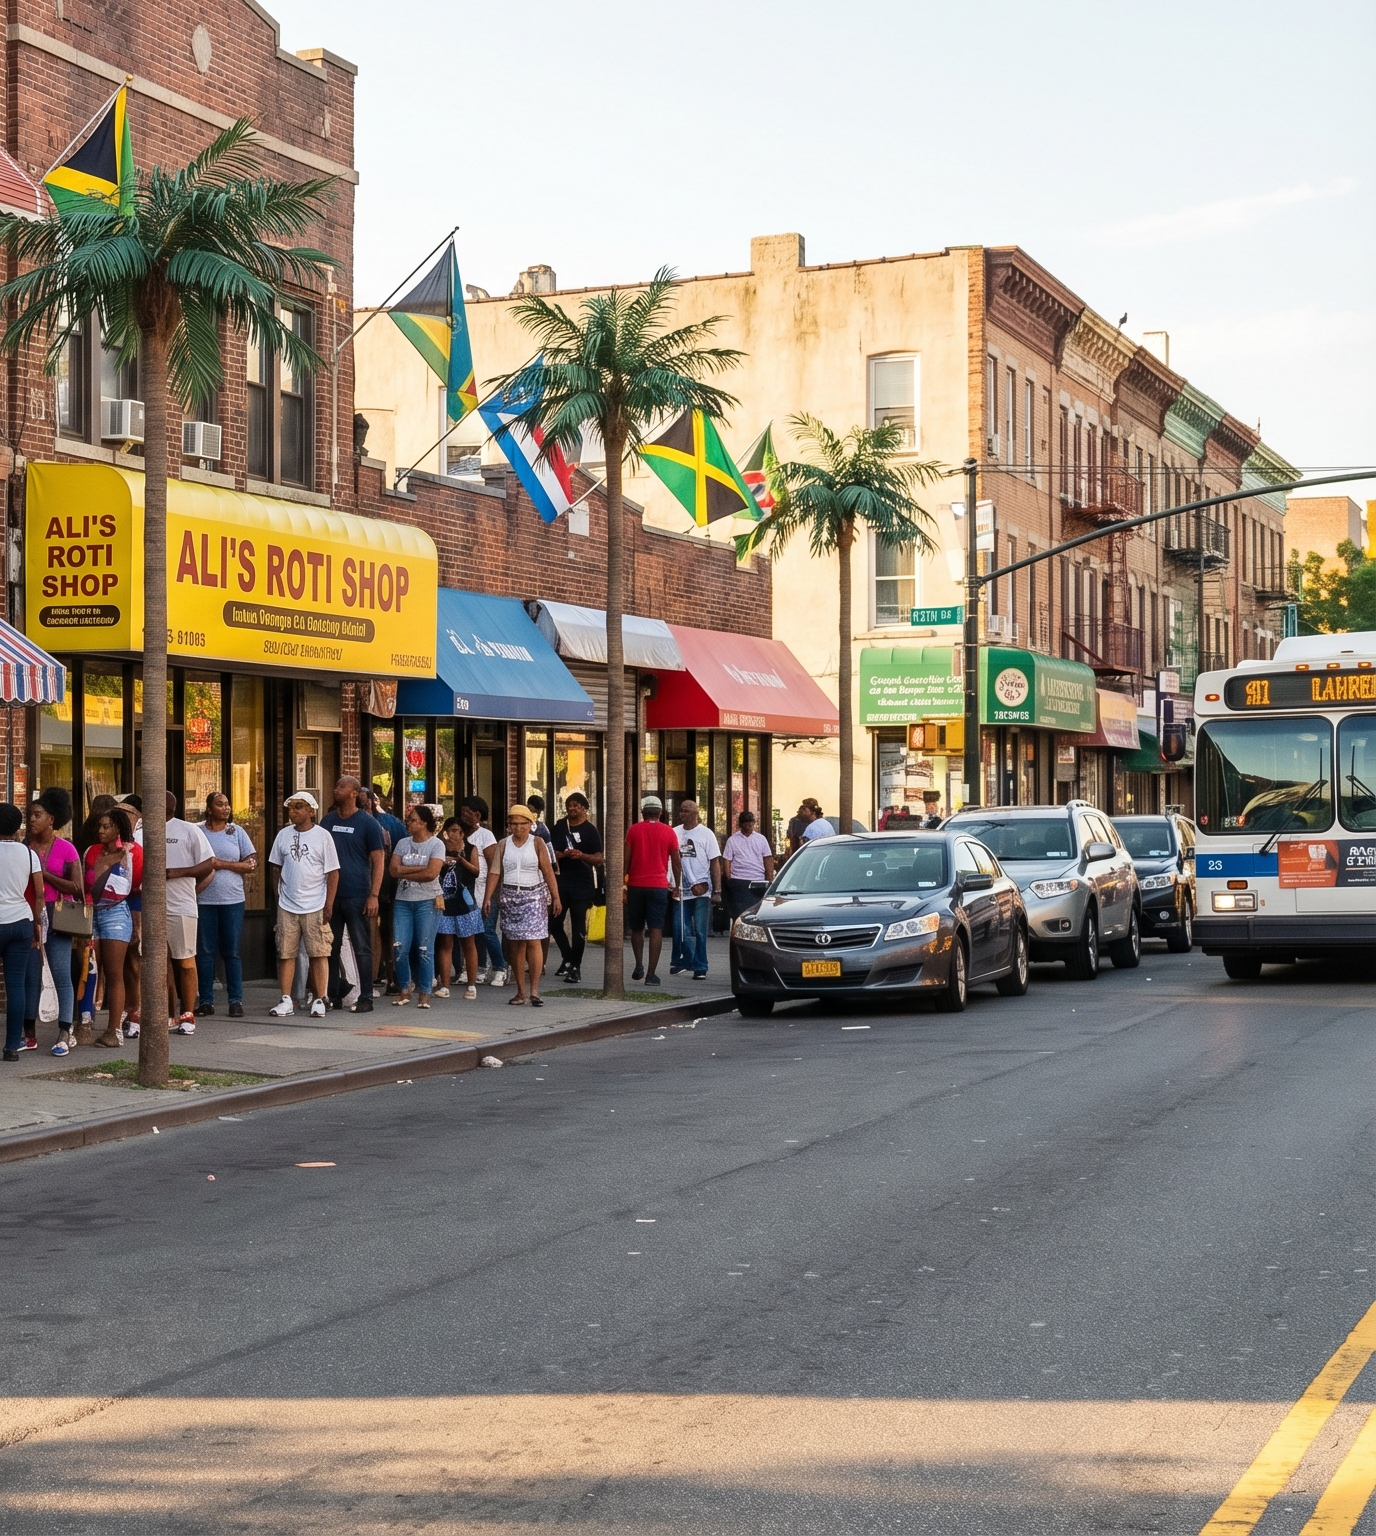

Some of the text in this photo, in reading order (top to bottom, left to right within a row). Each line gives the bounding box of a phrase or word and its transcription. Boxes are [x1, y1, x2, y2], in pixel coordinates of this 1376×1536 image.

[45, 514, 116, 540] ALI'S
[47, 543, 113, 568] ROTI
[176, 529, 410, 614] ALI'S ROTI SHOP
[42, 573, 119, 598] SHOP
